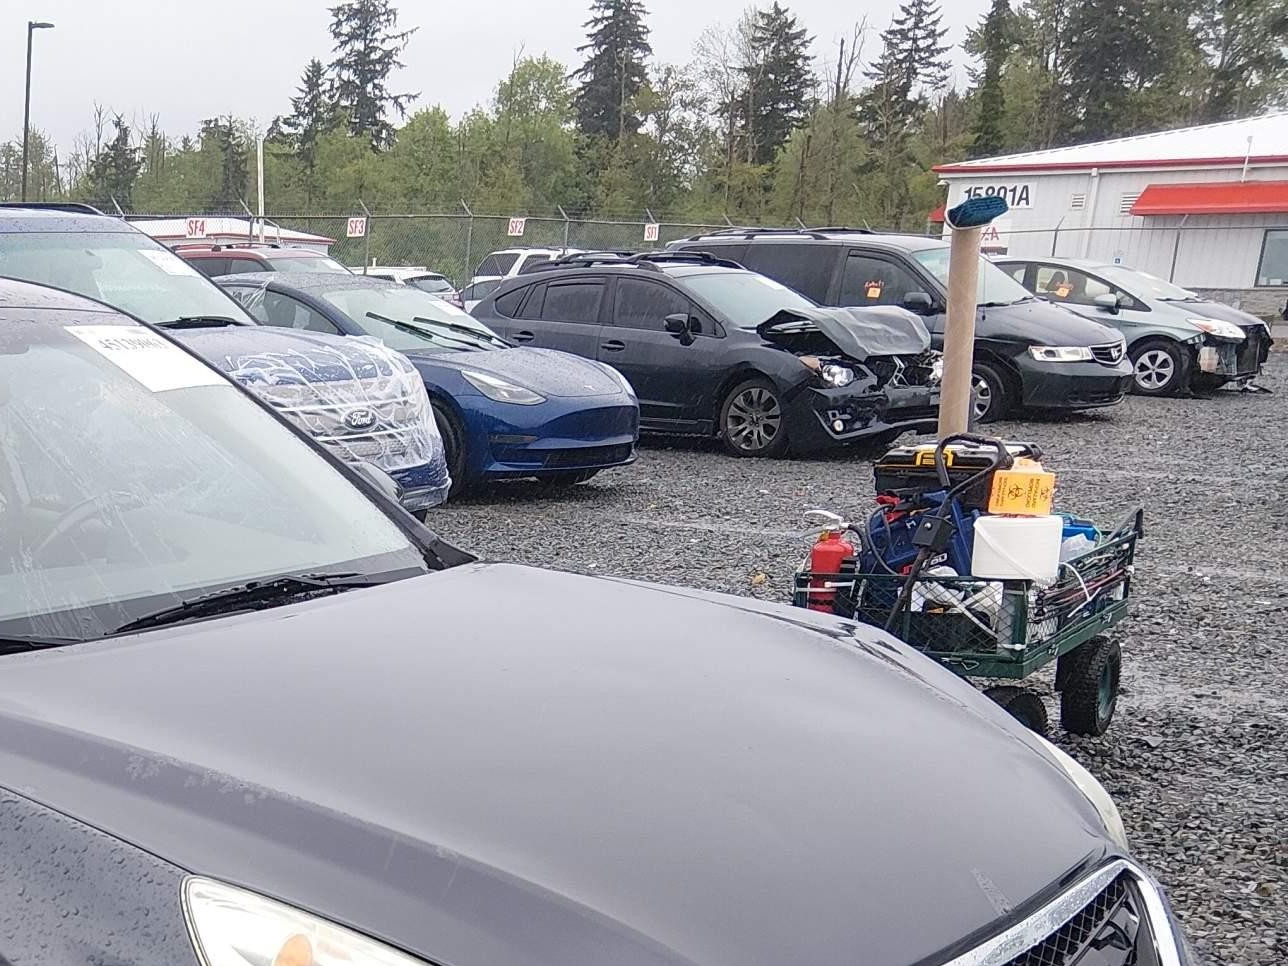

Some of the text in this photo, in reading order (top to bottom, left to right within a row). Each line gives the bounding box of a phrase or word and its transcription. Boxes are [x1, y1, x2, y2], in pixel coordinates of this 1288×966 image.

[188, 219, 205, 236] SF4
[348, 219, 364, 234] SF3
[509, 220, 523, 234] SF2
[646, 226, 657, 239] SF1
[350, 410, 372, 426] Ford
